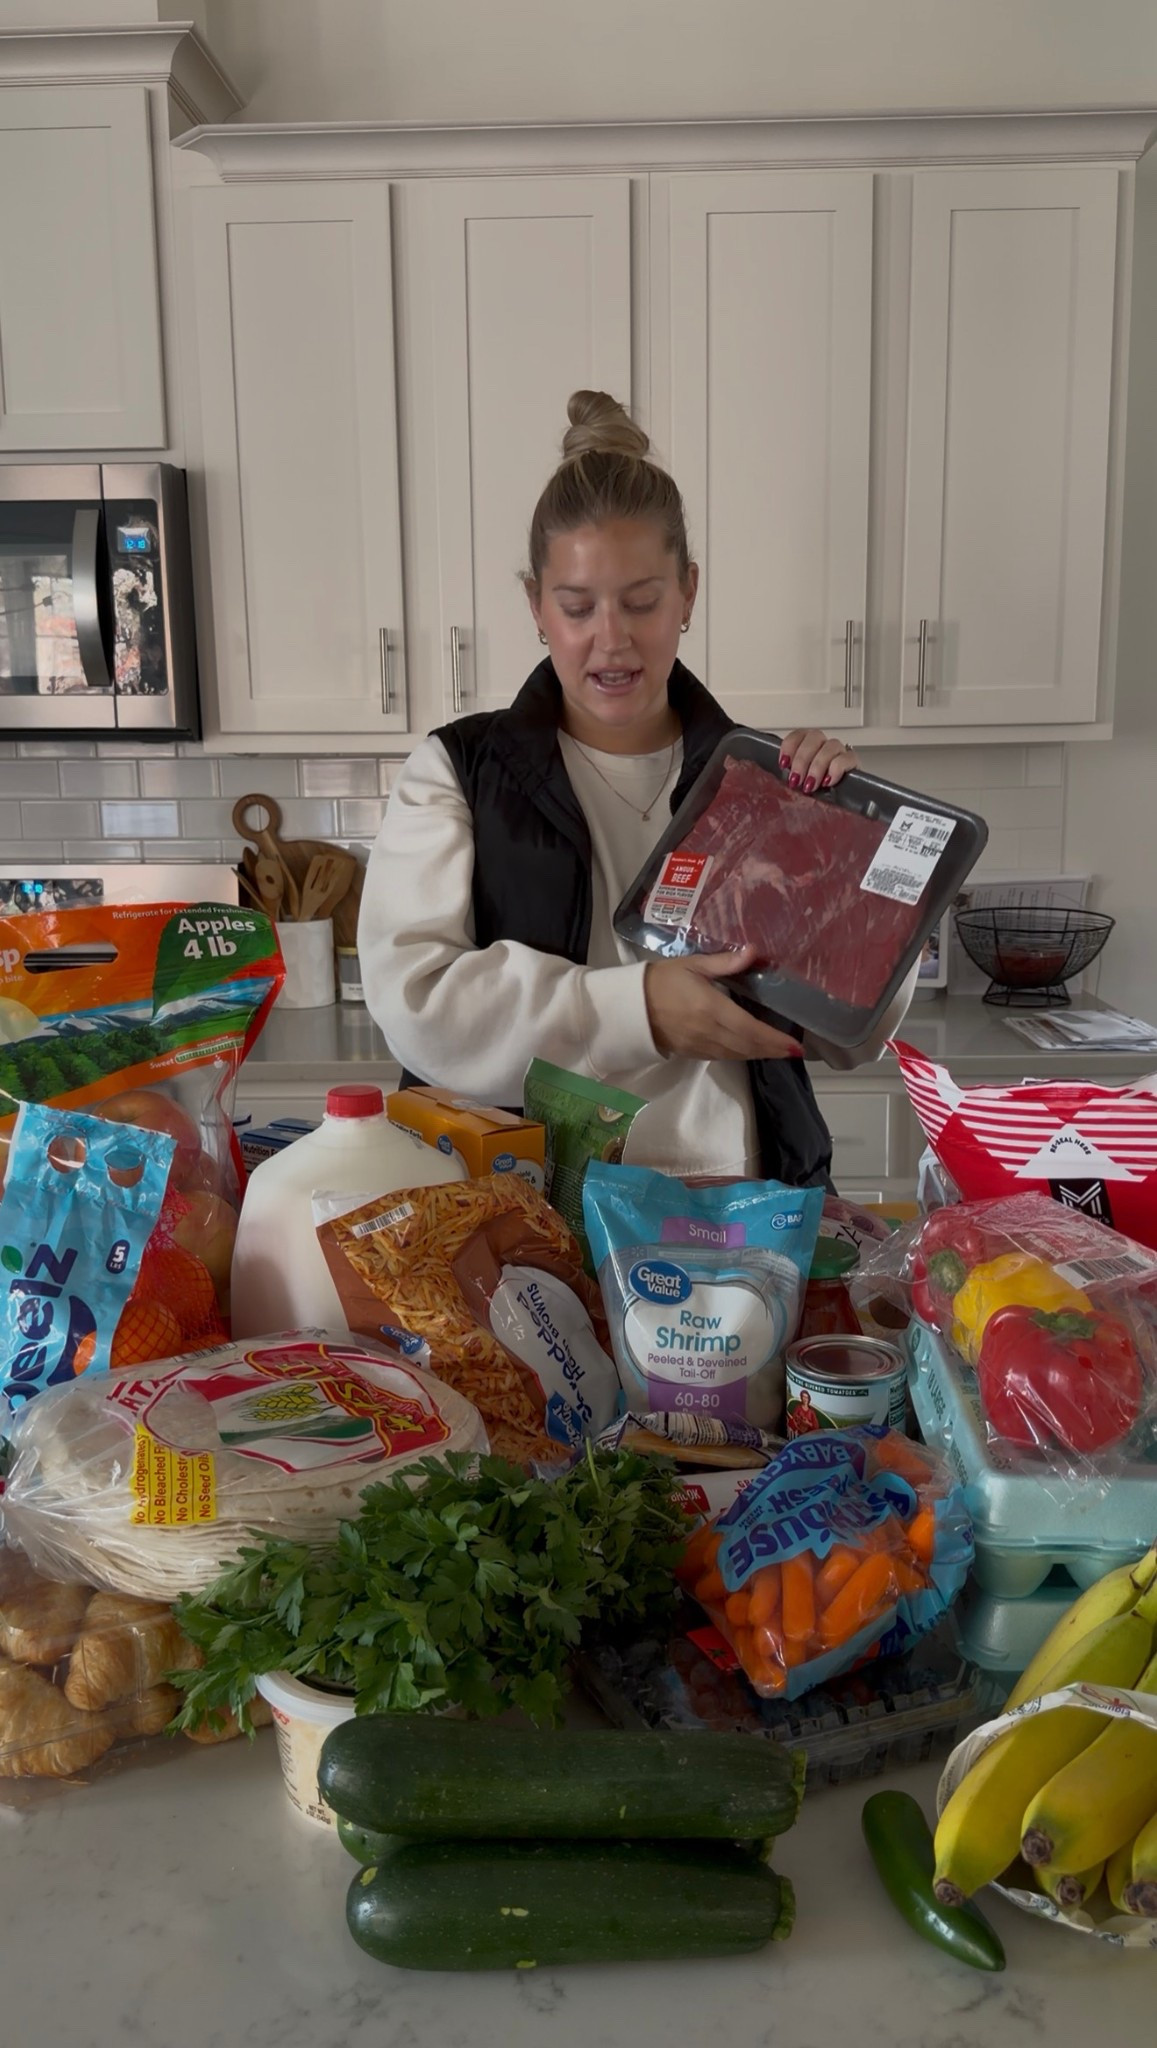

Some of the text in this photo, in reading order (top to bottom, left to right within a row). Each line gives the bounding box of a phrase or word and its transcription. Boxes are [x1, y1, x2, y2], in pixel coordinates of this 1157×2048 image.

[671, 873, 691, 883] BEEF
[112, 909, 158, 920] Refrigerate
[173, 907, 211, 915] Extended
[177, 916, 256, 935] Apples
[183, 937, 237, 959] 4 lb
[150, 1057, 175, 1069] Sweet
[243, 1144, 270, 1156] Nutrition
[1050, 1137, 1092, 1156] RE-SEAL HERE
[688, 1223, 727, 1243] Small
[113, 1246, 125, 1262] 5
[637, 1266, 682, 1289] Great
[648, 1282, 681, 1298] Value
[527, 1283, 559, 1337] Browns
[680, 1310, 721, 1329] Raw
[656, 1327, 741, 1355] Shrimp
[648, 1352, 747, 1368] Peeled & Deveined
[679, 1368, 716, 1379] Tail-Off
[805, 1383, 825, 1393] RIPENED
[674, 1392, 720, 1407] 60-80
[739, 1441, 848, 1500] BABY-CUT
[154, 1456, 166, 1506] Bleached
[175, 1456, 188, 1521] No Cholest
[198, 1474, 211, 1501] Seed
[154, 1509, 166, 1524] No
[199, 1503, 211, 1518] No
[728, 1488, 910, 1579] BHOUSE
